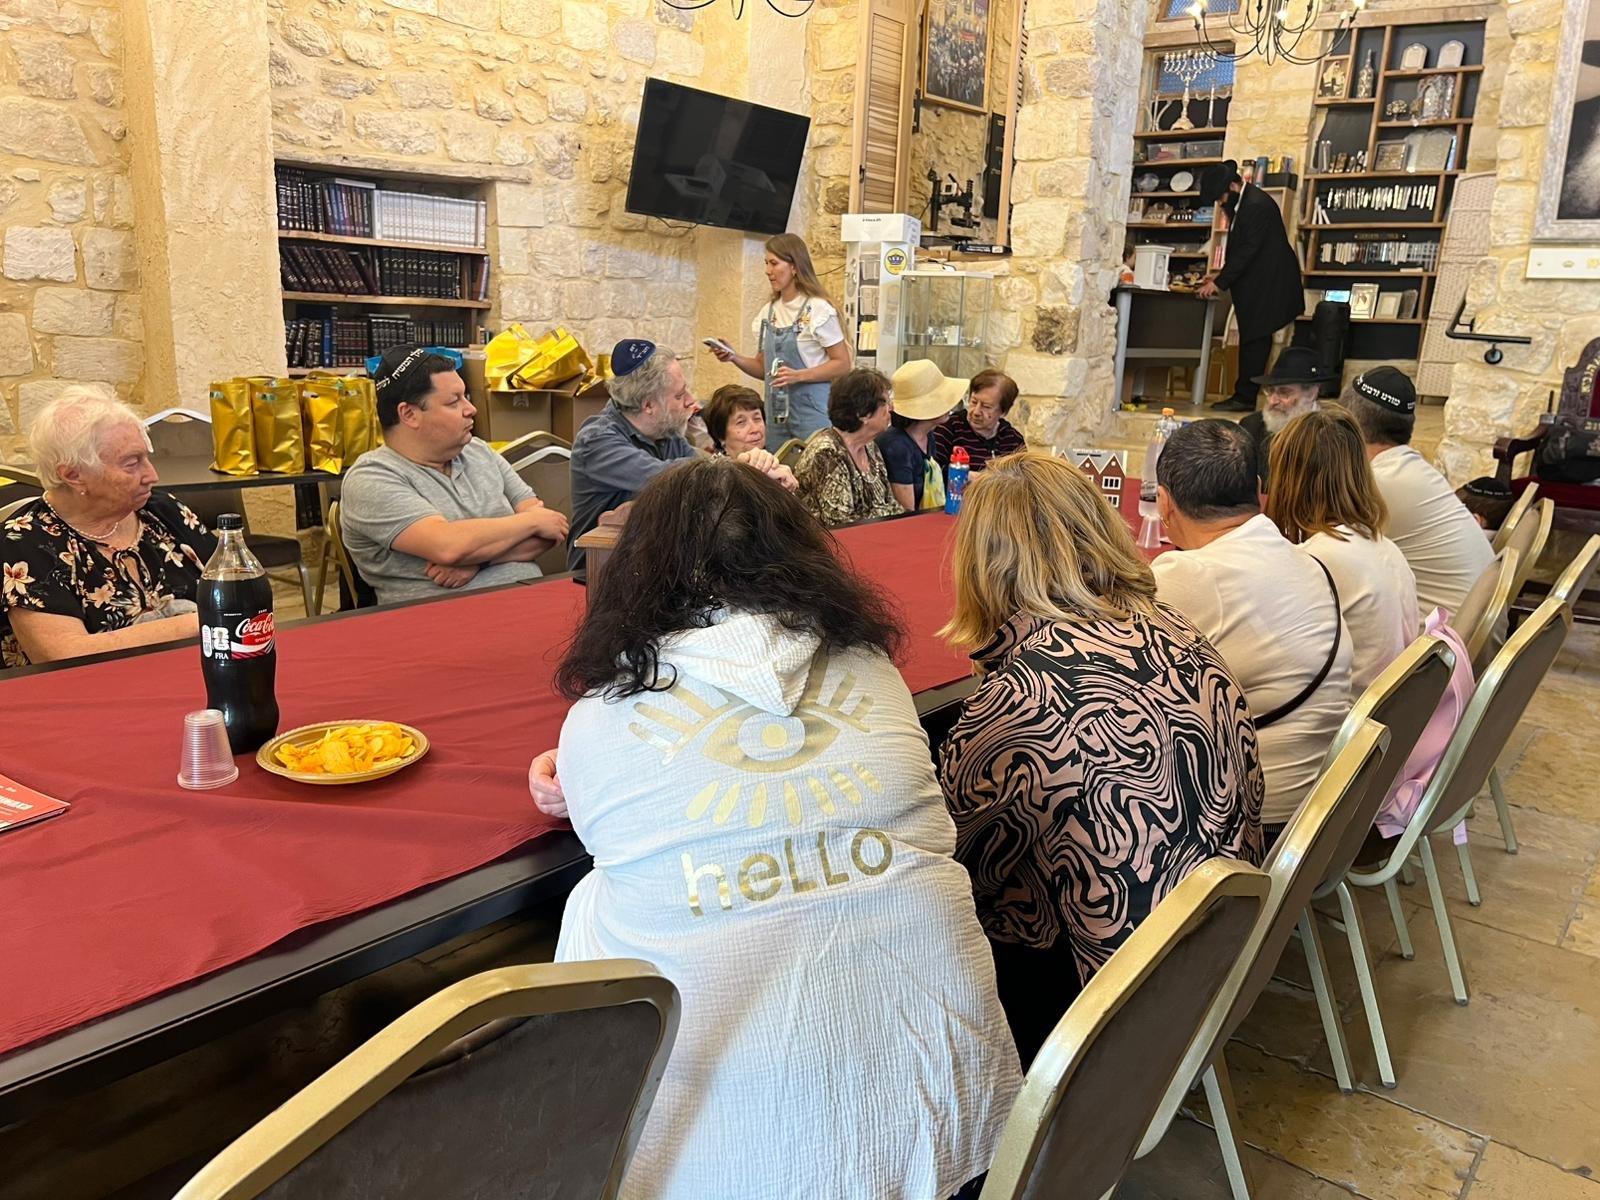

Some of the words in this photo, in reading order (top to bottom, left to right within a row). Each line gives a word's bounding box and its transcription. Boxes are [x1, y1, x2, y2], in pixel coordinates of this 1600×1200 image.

[392, 356, 415, 380] המשיח
[235, 612, 274, 638] Coca-Col
[215, 652, 229, 660] FRA
